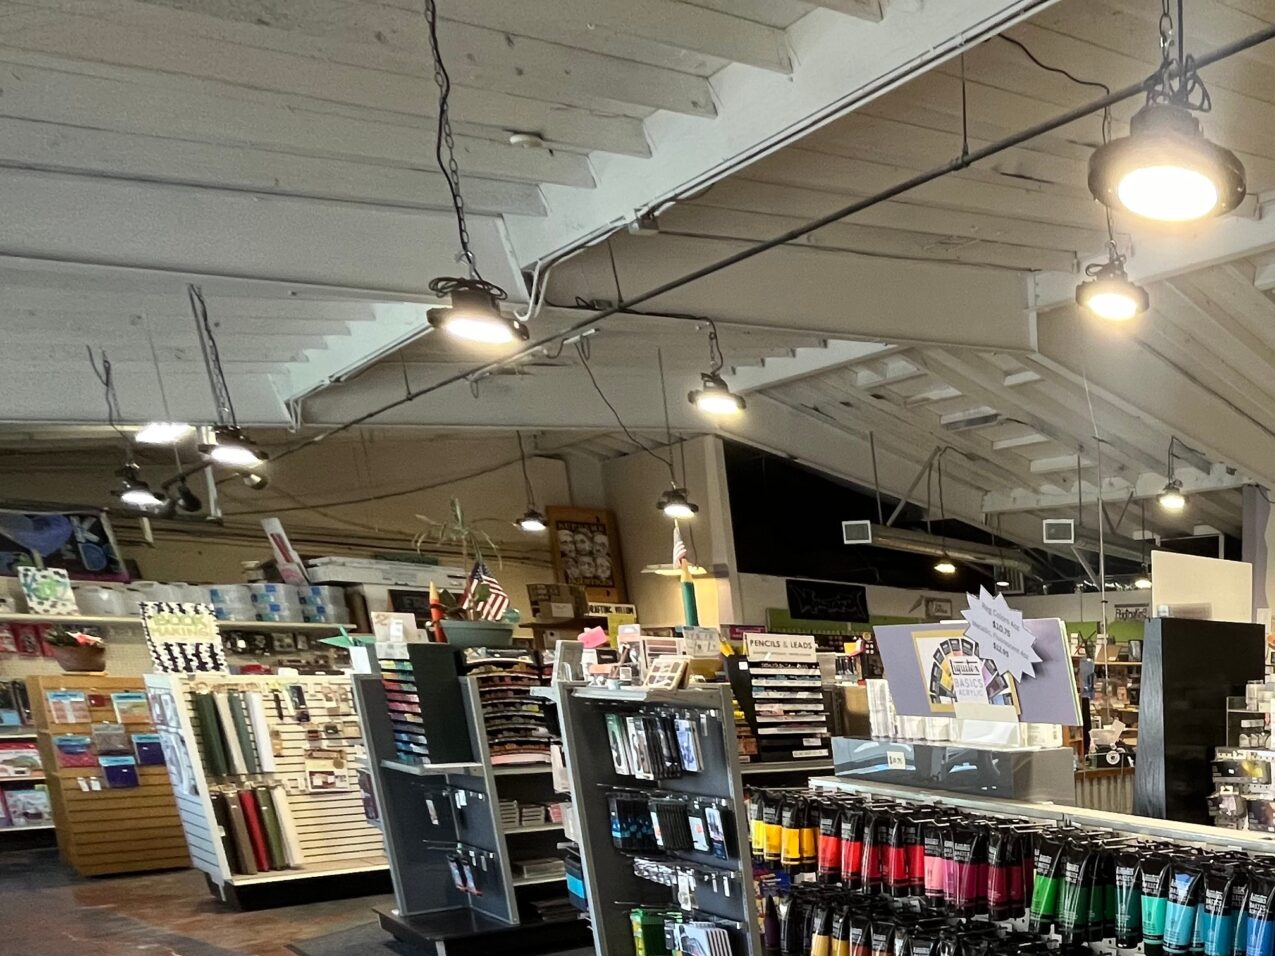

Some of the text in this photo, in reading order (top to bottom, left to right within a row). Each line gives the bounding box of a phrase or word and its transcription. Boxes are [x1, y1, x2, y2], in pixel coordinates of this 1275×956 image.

[750, 639, 781, 648] PENCILS
[790, 641, 813, 650] LEADS
[954, 678, 984, 688] BASICS
